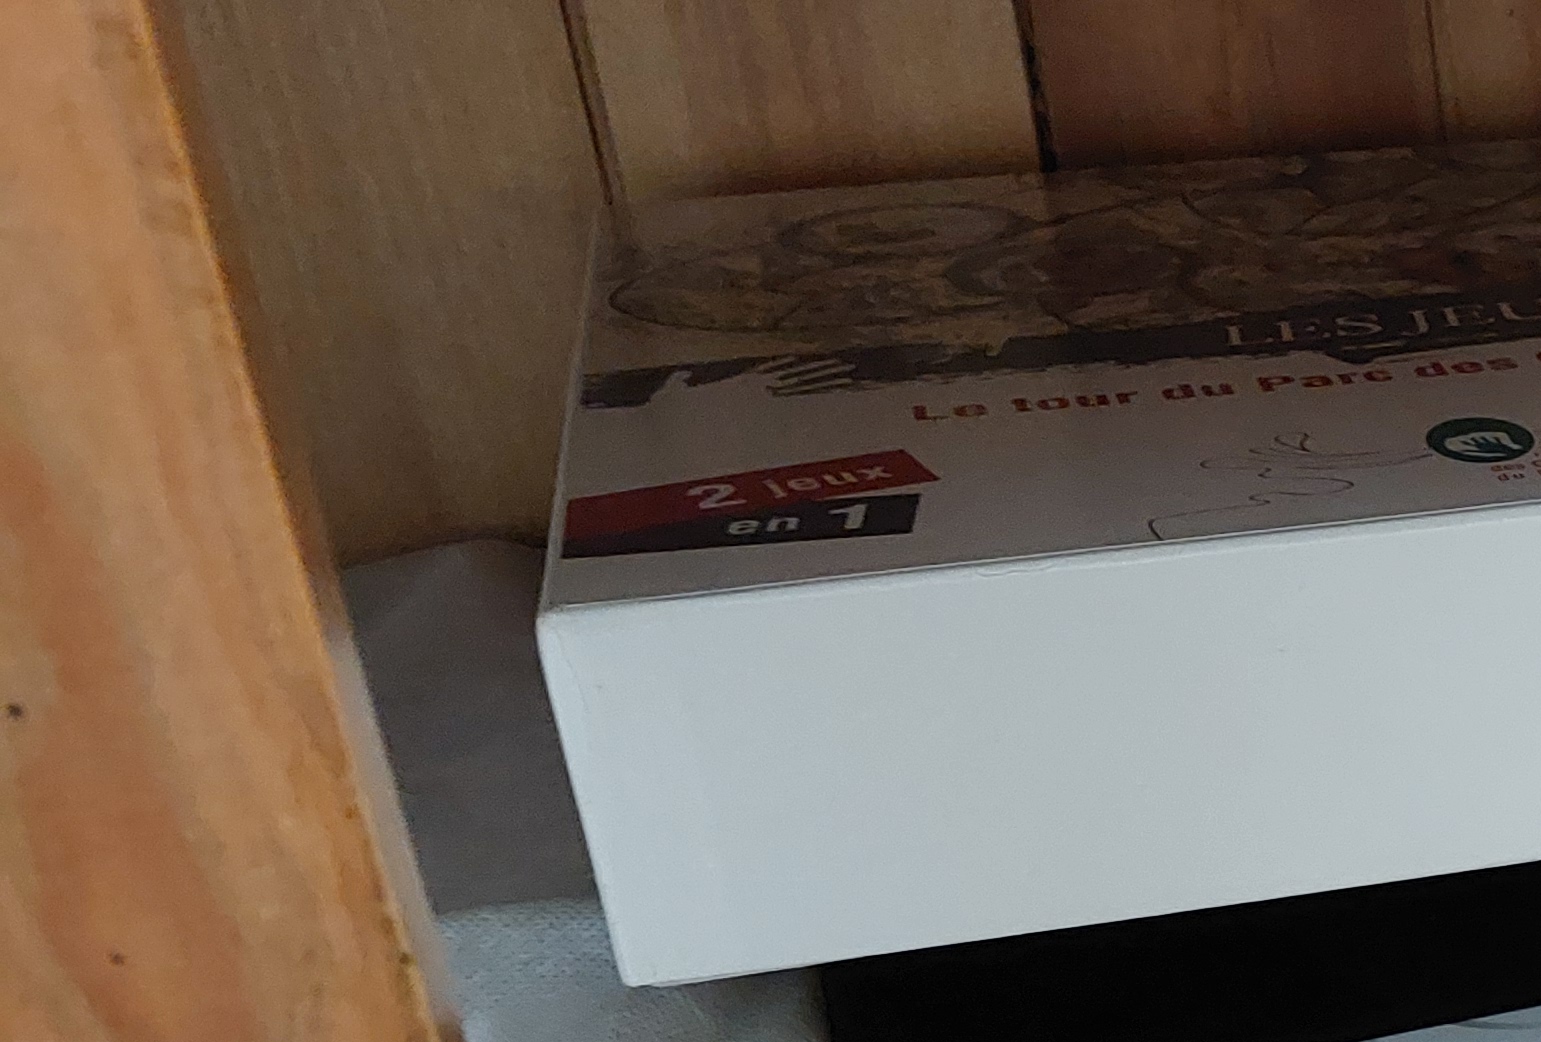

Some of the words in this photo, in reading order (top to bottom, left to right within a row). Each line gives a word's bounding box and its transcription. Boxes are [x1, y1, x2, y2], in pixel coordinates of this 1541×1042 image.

[1224, 310, 1378, 348] LES
[1010, 390, 1139, 413] tour
[1162, 381, 1236, 401] du
[1258, 363, 1395, 392] Parc
[1414, 355, 1521, 380] des
[687, 481, 747, 511] 2
[725, 511, 800, 537] en
[827, 502, 870, 531] 1
